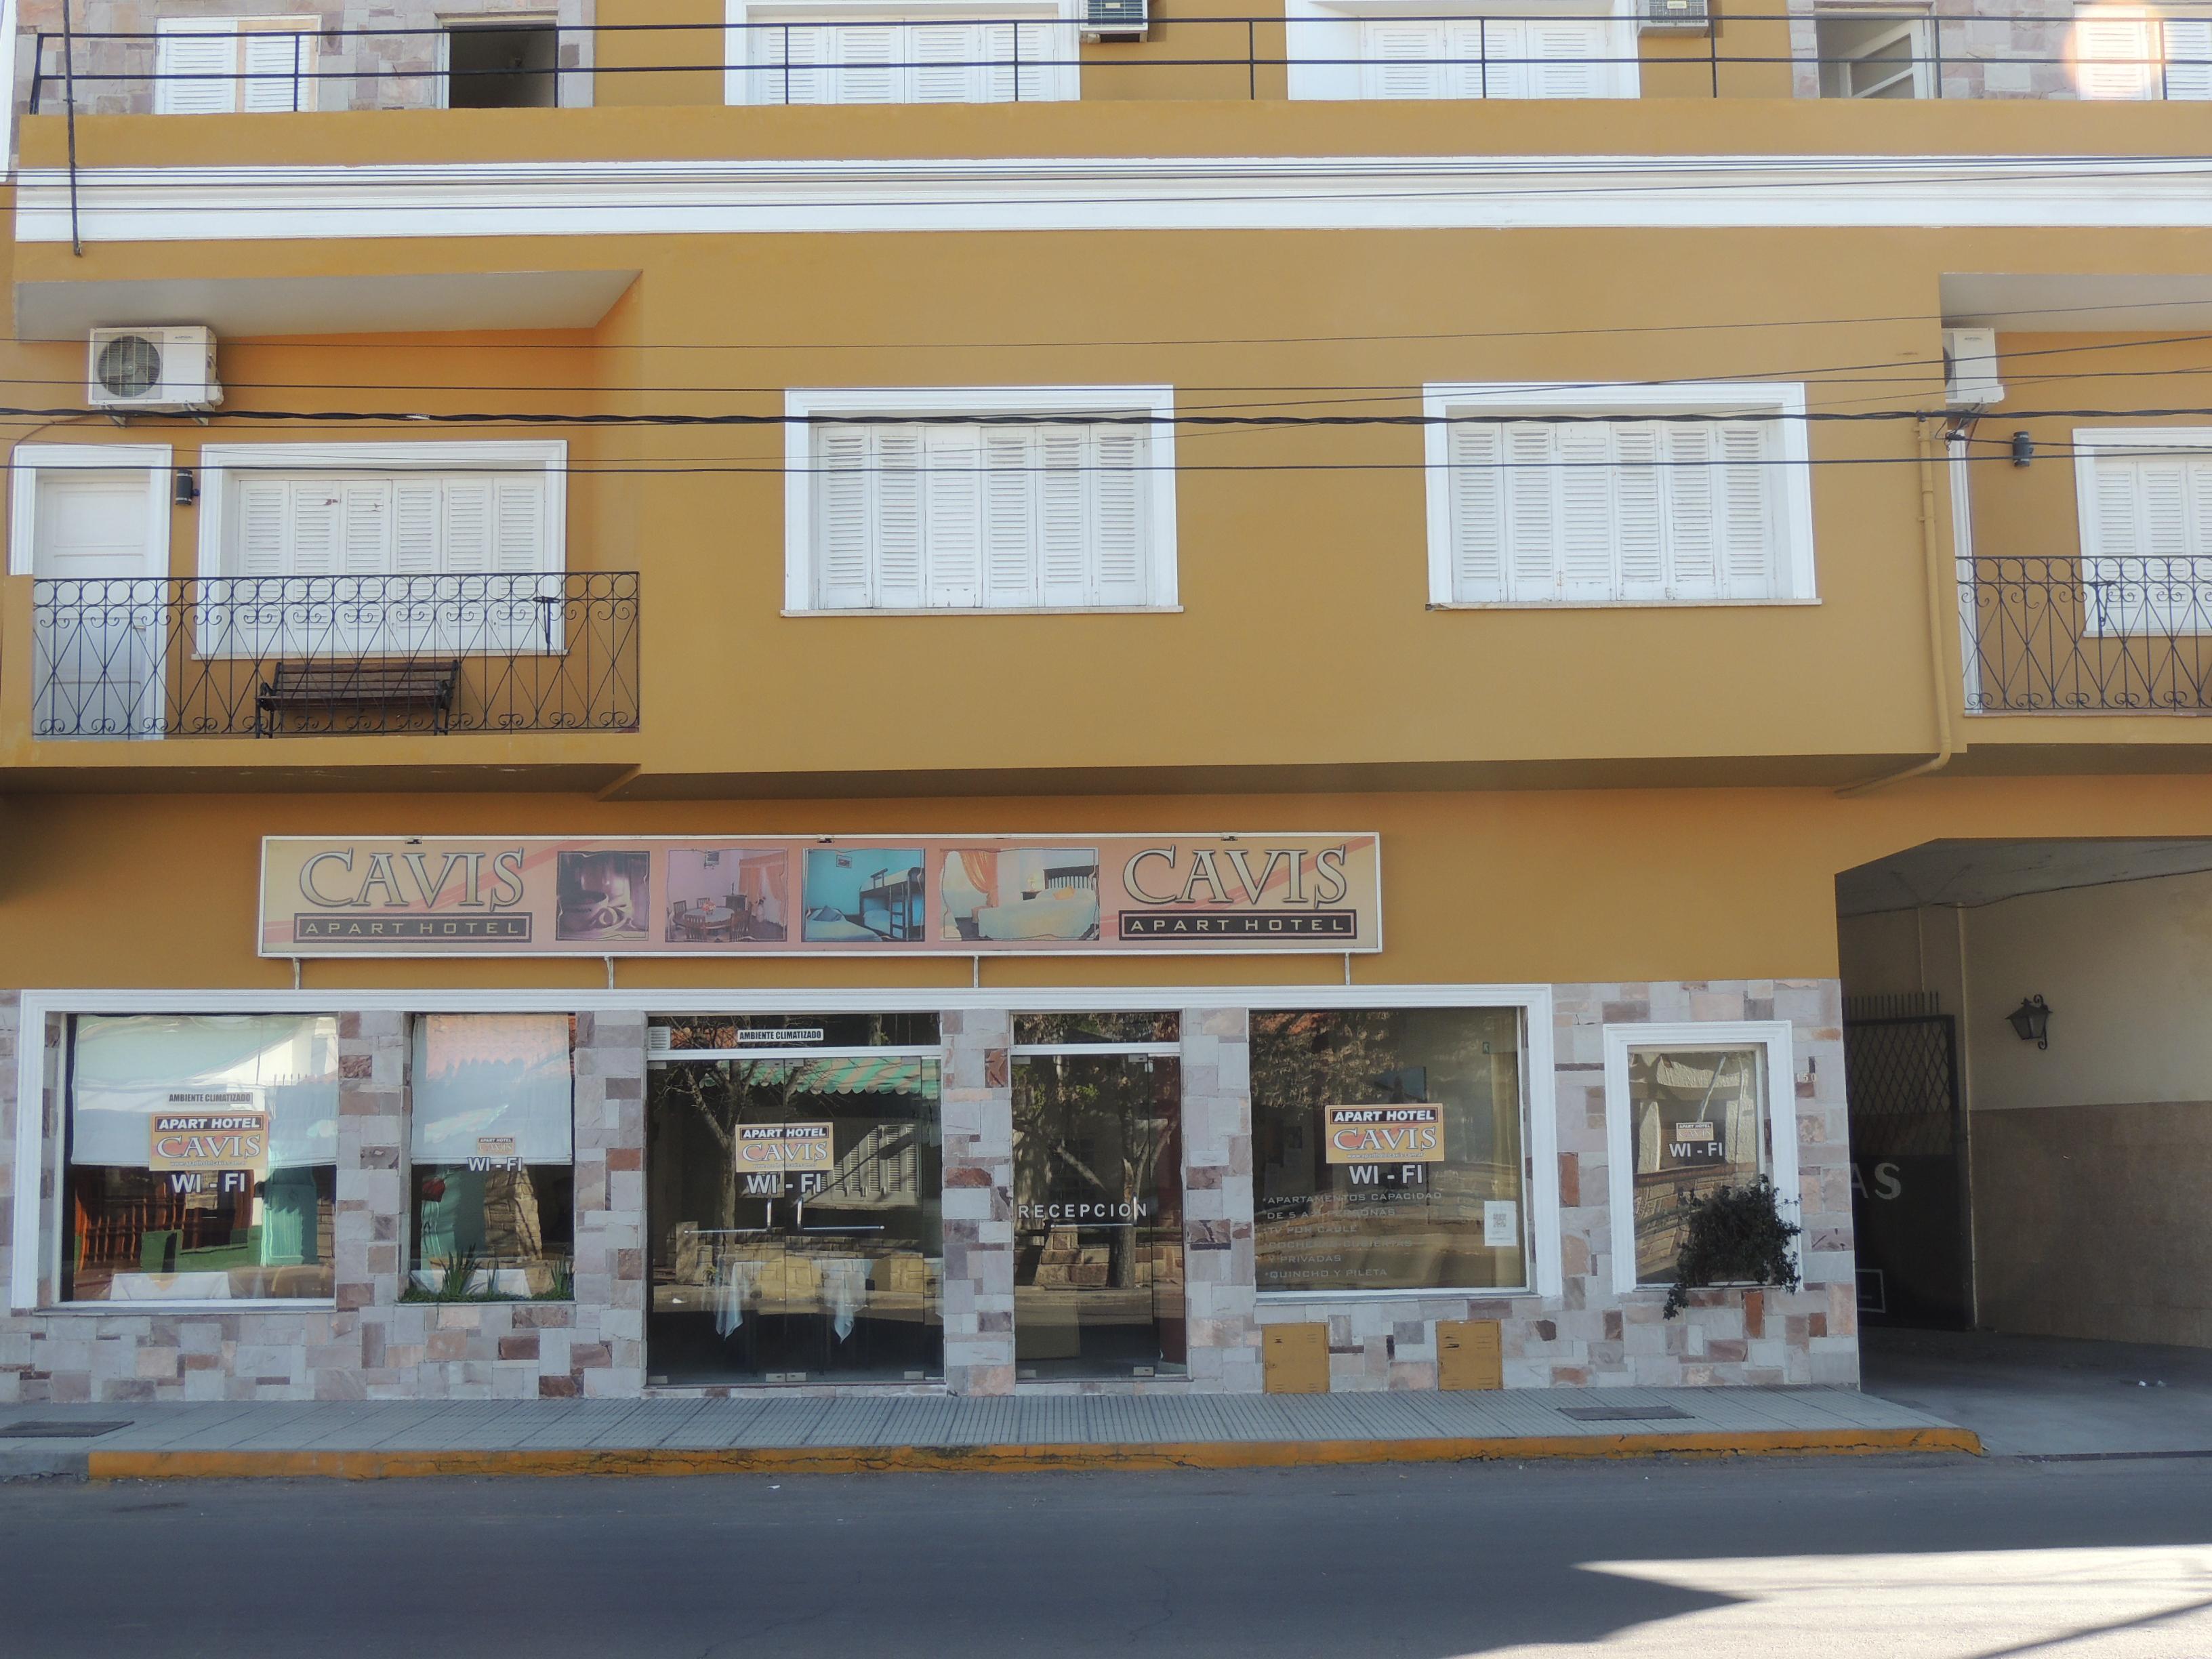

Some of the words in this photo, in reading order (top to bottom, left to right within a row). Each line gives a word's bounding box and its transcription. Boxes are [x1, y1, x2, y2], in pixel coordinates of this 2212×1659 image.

[300, 847, 524, 912] CAVIS
[1123, 844, 1347, 909] CAVIS
[306, 923, 403, 934] APART
[420, 922, 518, 934] HOTEL
[1130, 920, 1229, 931] APART
[1245, 919, 1343, 930] HOTEL
[739, 1031, 774, 1040] AMBIENTE
[775, 1030, 821, 1040] CLIMATIZADO
[1797, 1073, 1816, 1083] 150
[169, 1094, 203, 1102] AMBIENTE
[205, 1092, 251, 1102] CLIMATIZADO
[1334, 1111, 1382, 1122] APART
[1387, 1110, 1435, 1120] HOTEL
[159, 1118, 207, 1130] APART
[211, 1118, 260, 1129] HOTEL
[743, 1129, 783, 1138] APART
[786, 1128, 826, 1137] HOTEL
[1333, 1126, 1437, 1151] CAVIS
[157, 1134, 260, 1159] CAVIS
[742, 1141, 828, 1162] CAVIS
[1669, 1143, 1692, 1158] WI
[1708, 1142, 1723, 1157] FI
[468, 1157, 490, 1172] WI
[507, 1157, 522, 1172] FI
[1349, 1165, 1379, 1185] WI
[1402, 1164, 1422, 1184] FI
[171, 1173, 201, 1193] WI
[225, 1172, 245, 1193] FI
[747, 1174, 777, 1194] WI
[801, 1173, 821, 1193] FI
[1267, 1193, 1366, 1204] APARTAMENTOS
[1371, 1192, 1441, 1201] CAPACIDAD
[1018, 1203, 1147, 1218] RECEPCION
[1287, 1225, 1312, 1233] POR
[1269, 1240, 1337, 1248] COCHE
[1280, 1254, 1341, 1263] PRIVADAS
[1269, 1270, 1328, 1279] QUINCHO
[1346, 1268, 1388, 1277] PILETA
